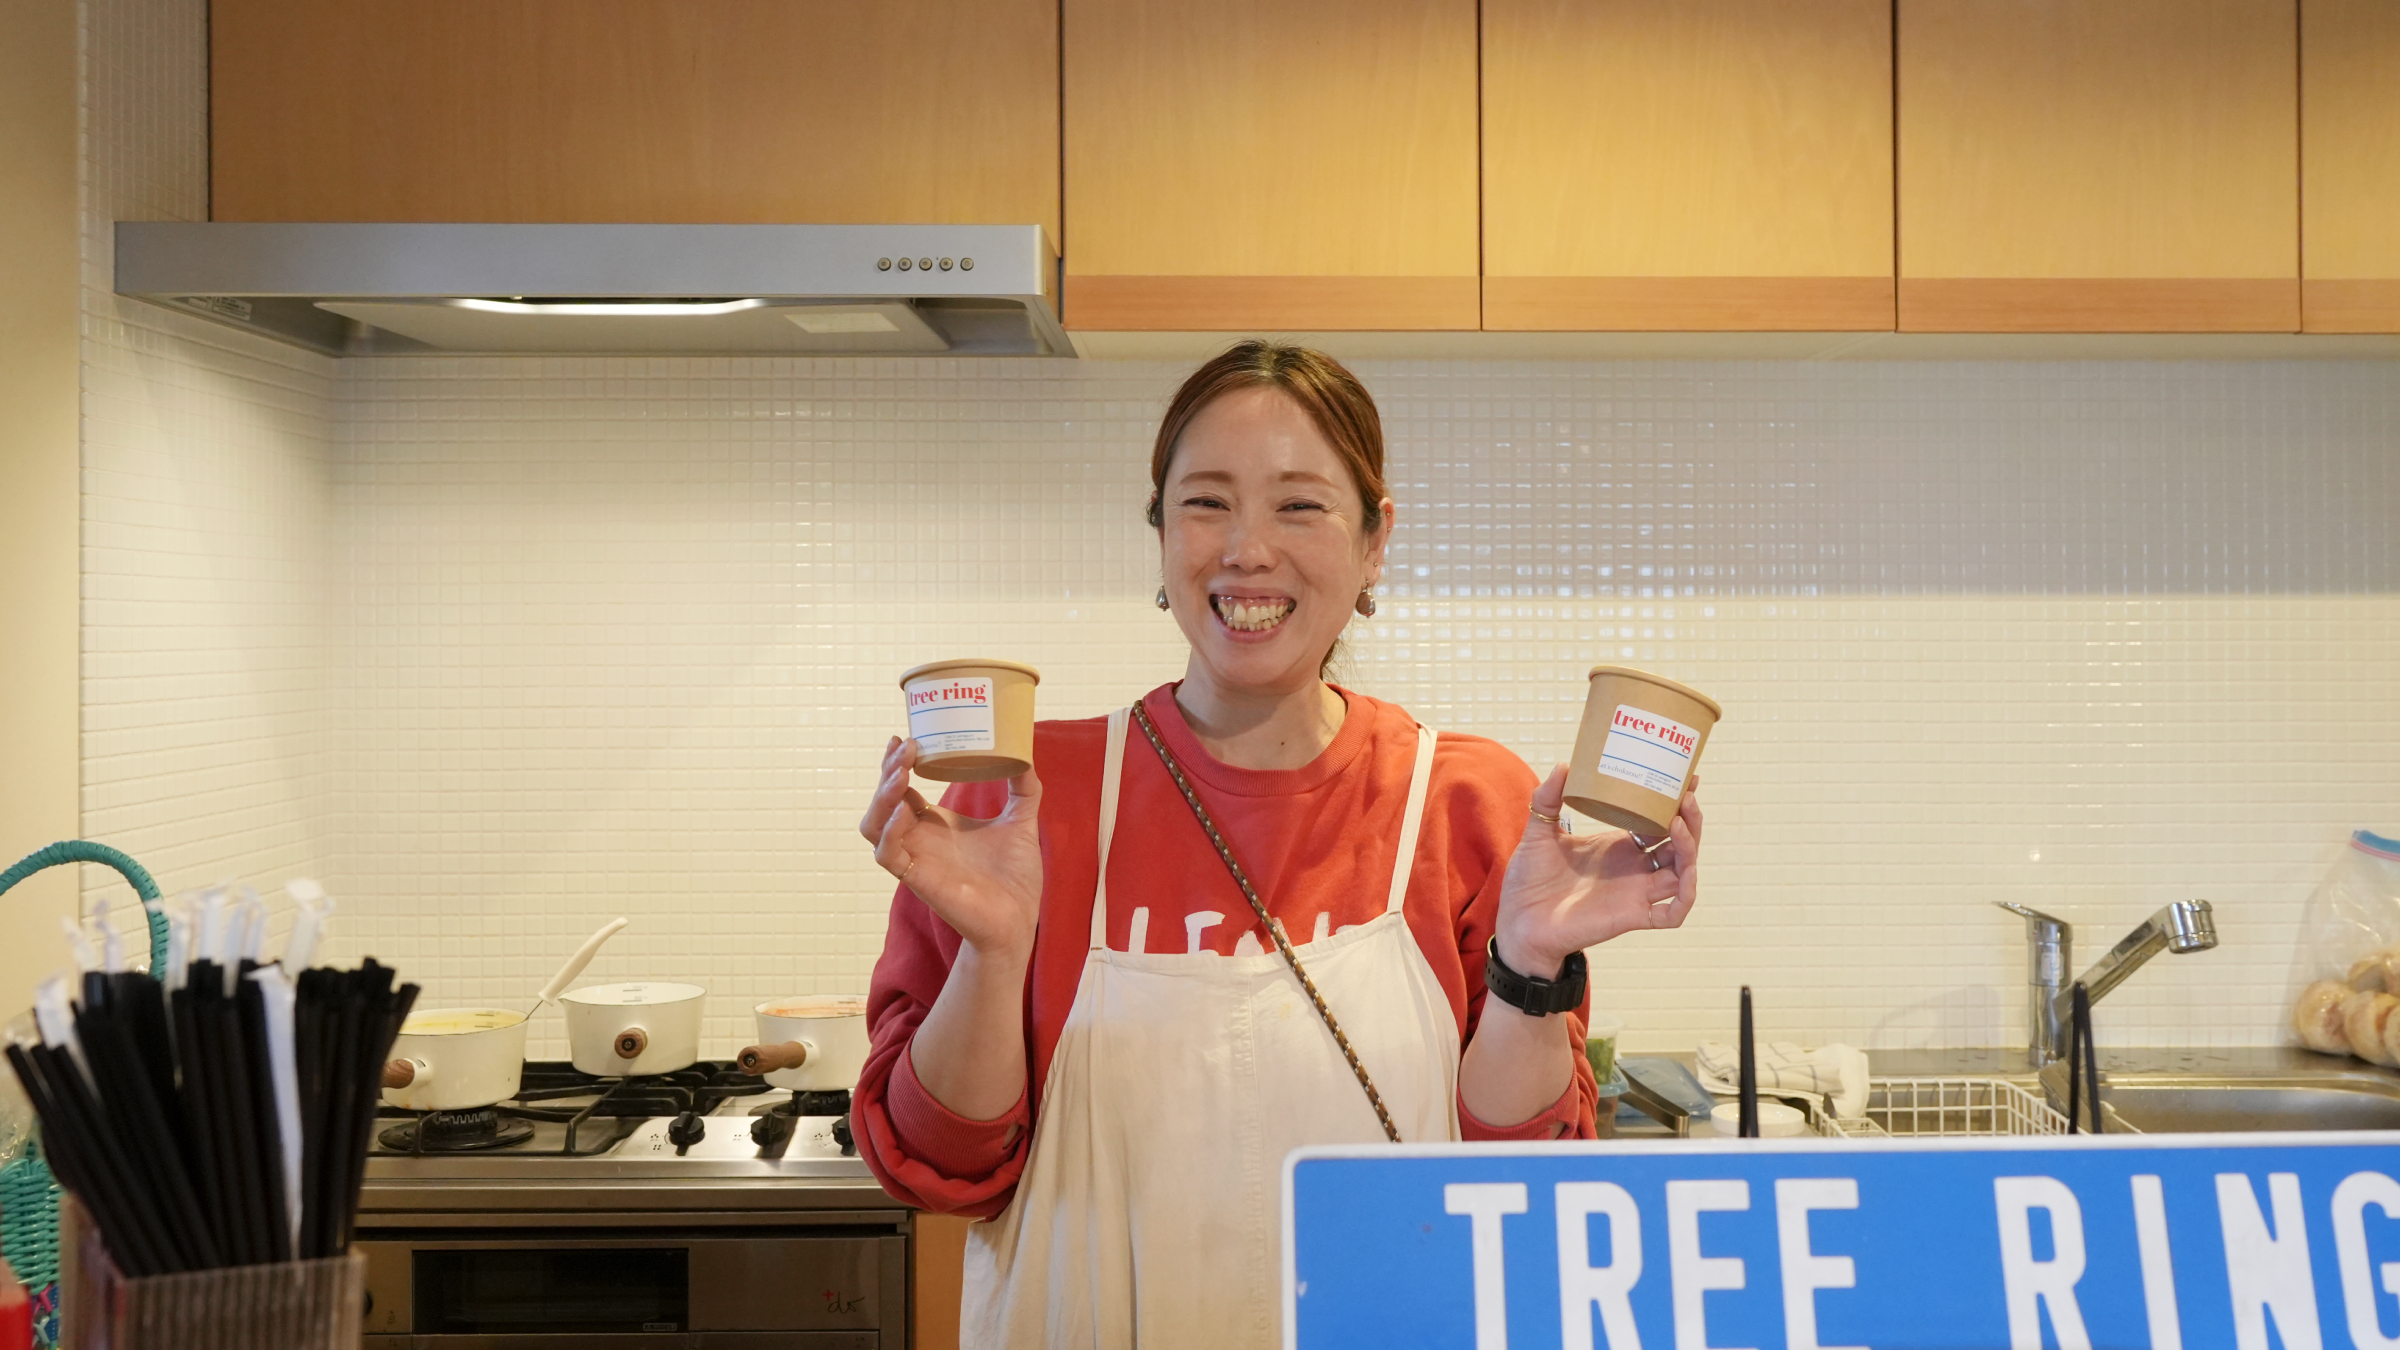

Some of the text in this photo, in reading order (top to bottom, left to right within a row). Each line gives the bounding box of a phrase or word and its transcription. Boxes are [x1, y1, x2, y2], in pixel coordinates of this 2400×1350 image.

[910, 682, 987, 706] tree ring
[1614, 710, 1695, 755] tree ring
[1444, 1171, 2400, 1350] TREE RING
